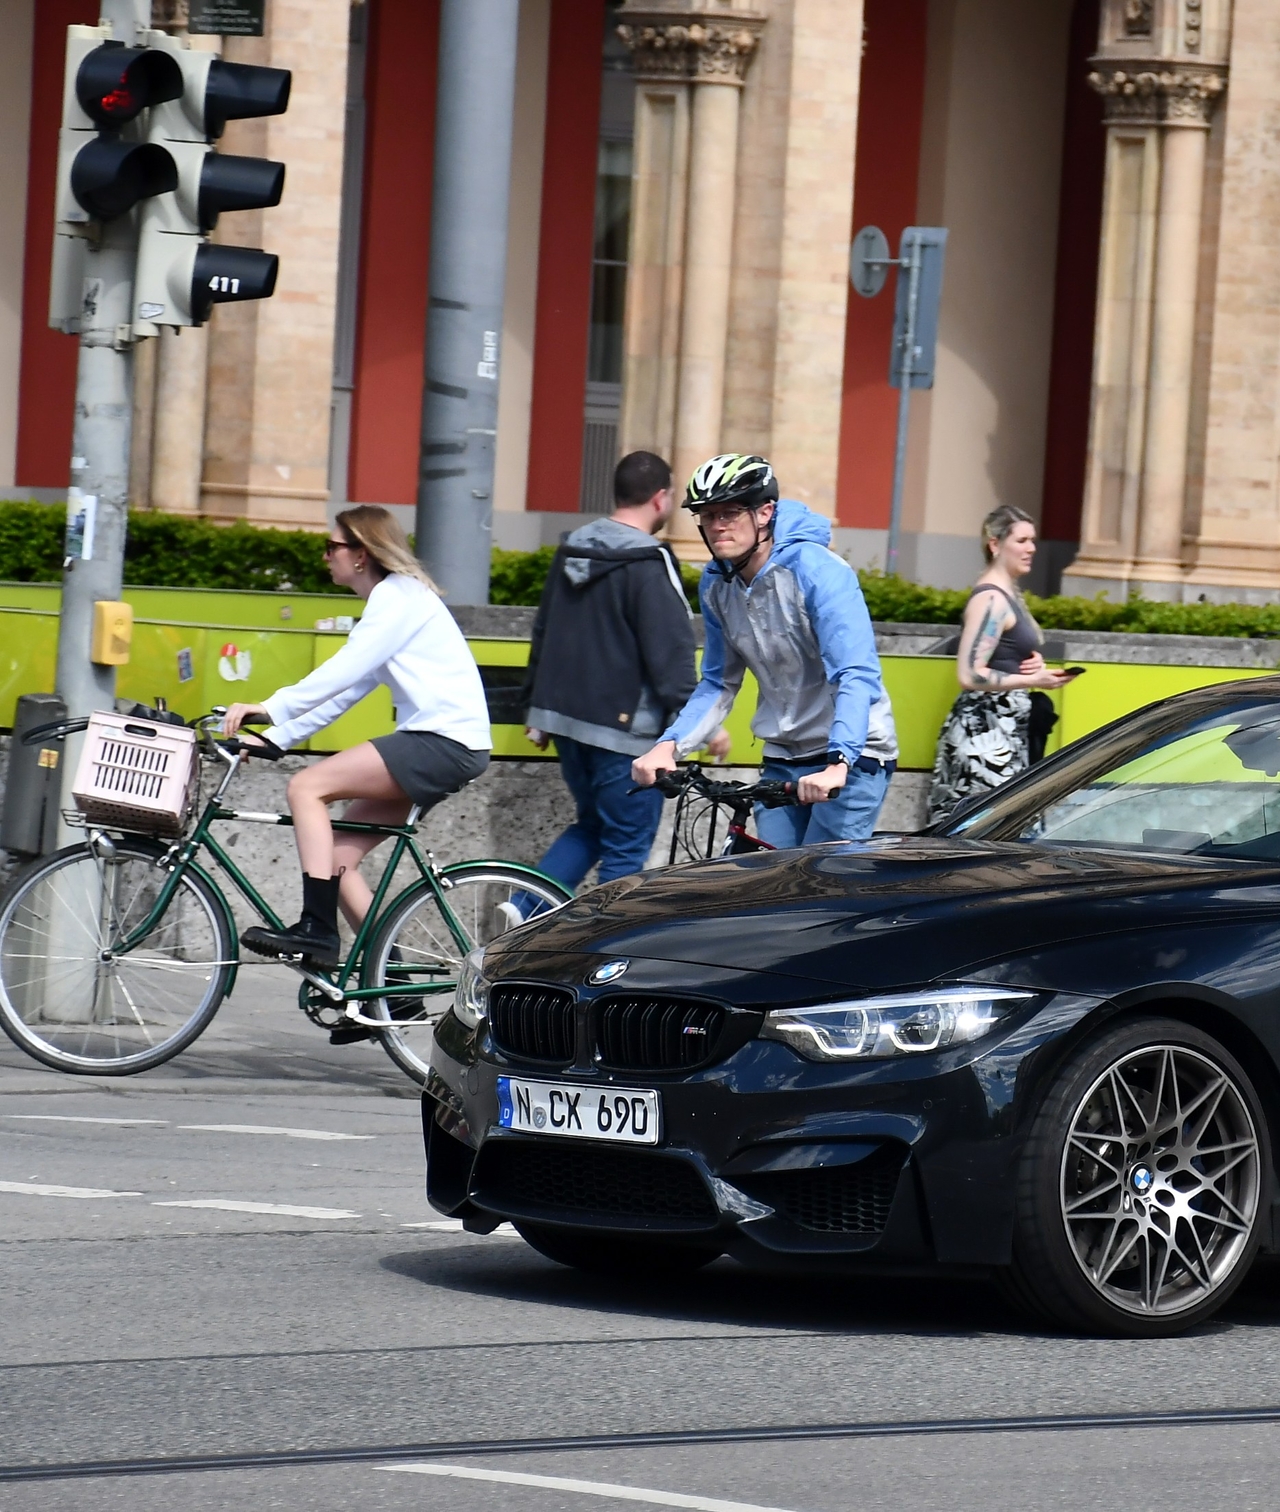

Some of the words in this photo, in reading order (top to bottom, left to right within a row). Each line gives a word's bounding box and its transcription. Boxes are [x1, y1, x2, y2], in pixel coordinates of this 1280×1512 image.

[208, 275, 240, 294] 411
[503, 1108, 510, 1119] D
[516, 1086, 531, 1125] N
[598, 1094, 648, 1135] 690
